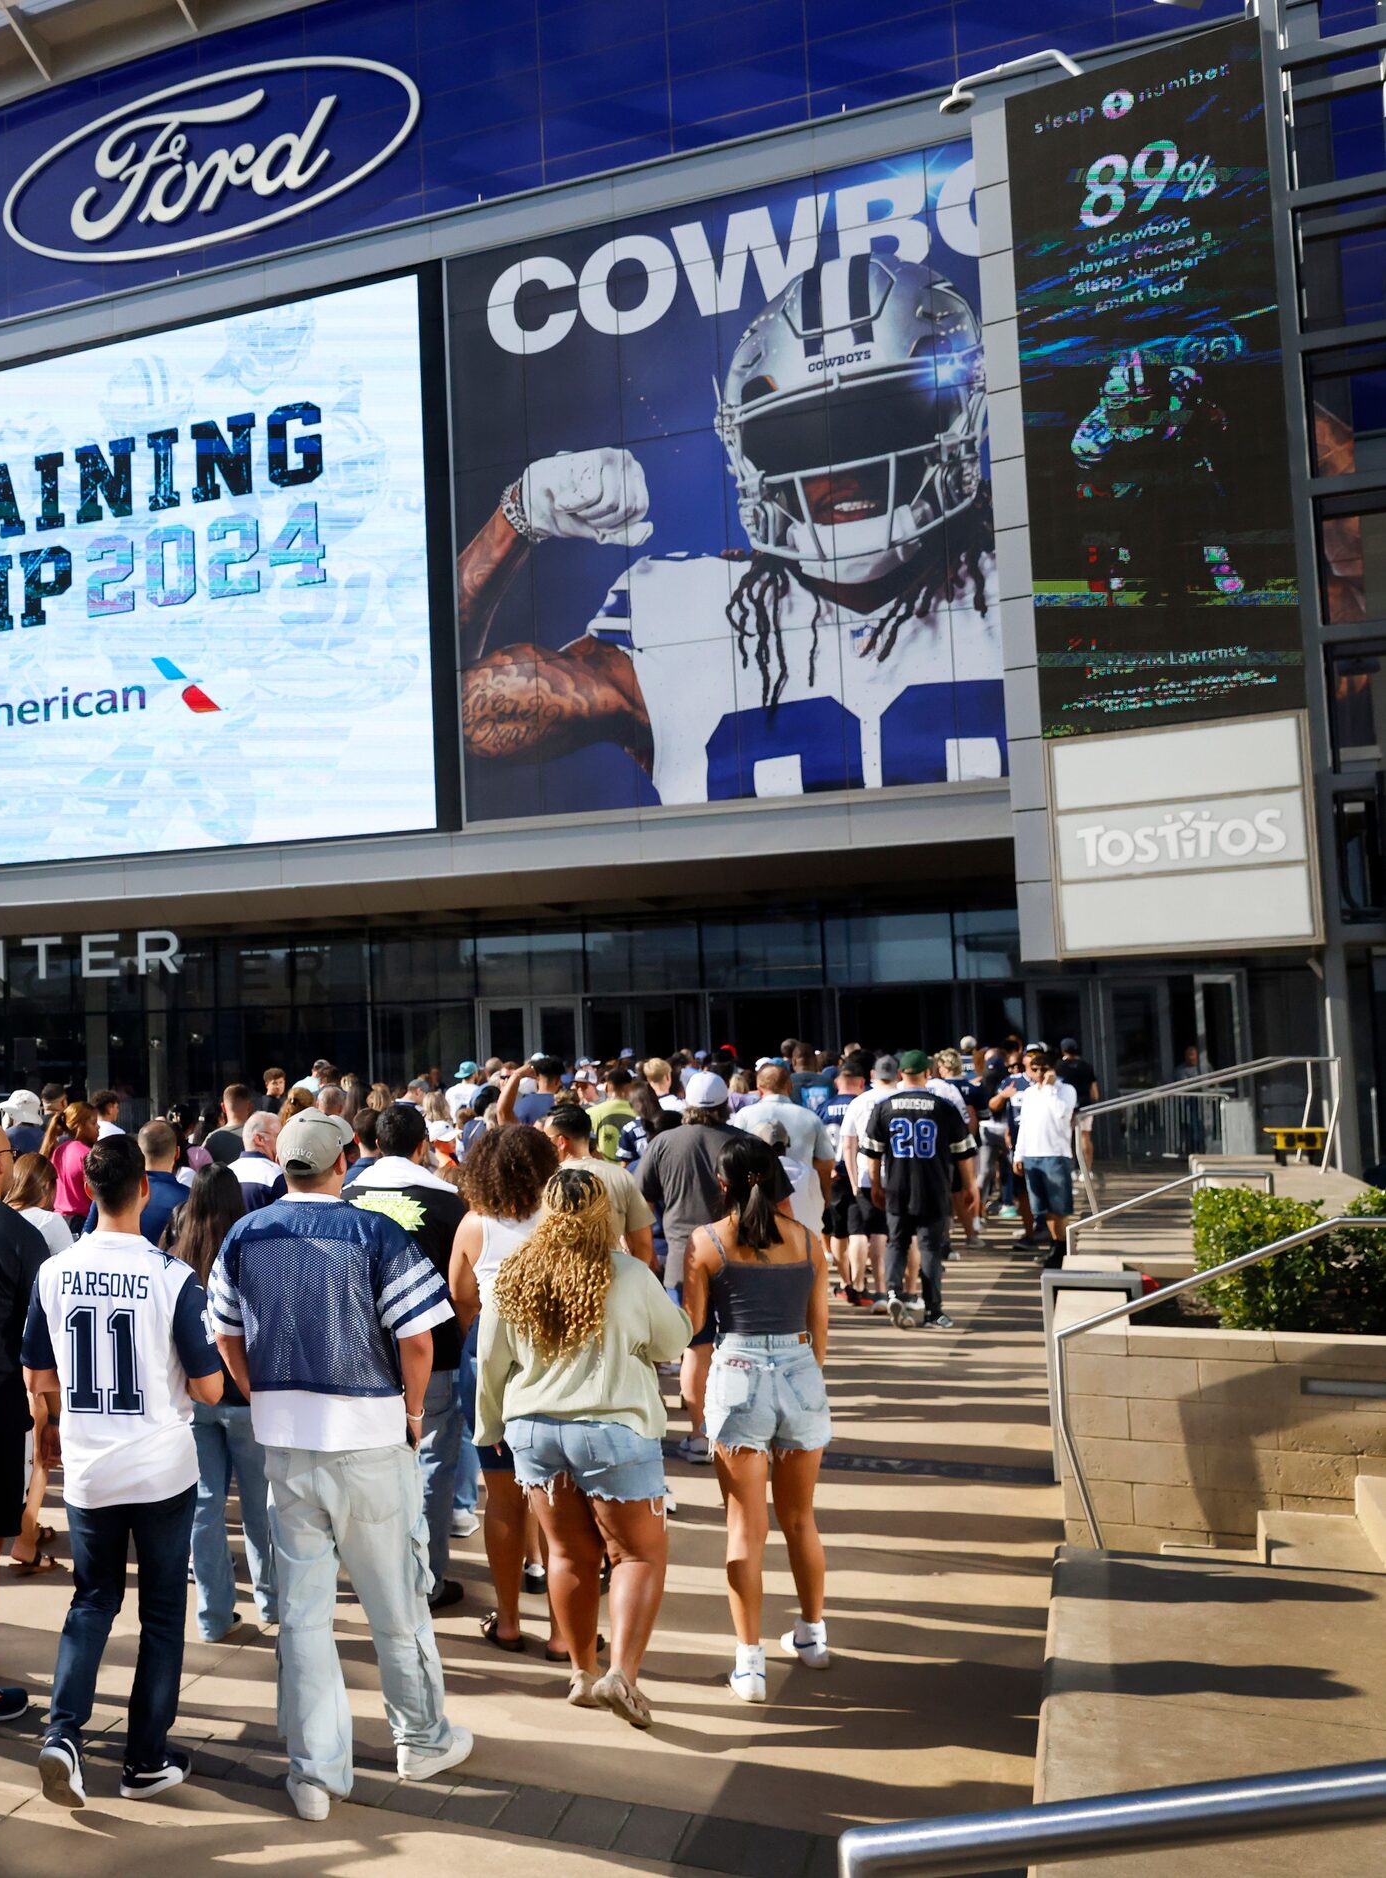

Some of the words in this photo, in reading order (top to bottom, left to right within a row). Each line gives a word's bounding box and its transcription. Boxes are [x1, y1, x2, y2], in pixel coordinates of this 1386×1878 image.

[1034, 106, 1095, 134] sleep
[70, 88, 338, 242] Ford
[1078, 139, 1217, 229] 89%
[1085, 234, 1106, 254] of
[1108, 215, 1191, 246] Cowboys
[1068, 253, 1129, 282] players
[1201, 231, 1212, 242] a
[1074, 275, 1123, 297] Sleep
[1127, 255, 1204, 282] Number
[1147, 277, 1186, 299] bed
[806, 348, 872, 374] COWBOYS
[85, 501, 327, 619] 2024
[890, 1098, 935, 1111] WOODSON
[888, 1117, 938, 1159] 28
[61, 1271, 150, 1299] PARSONS
[65, 1305, 145, 1416] 11
